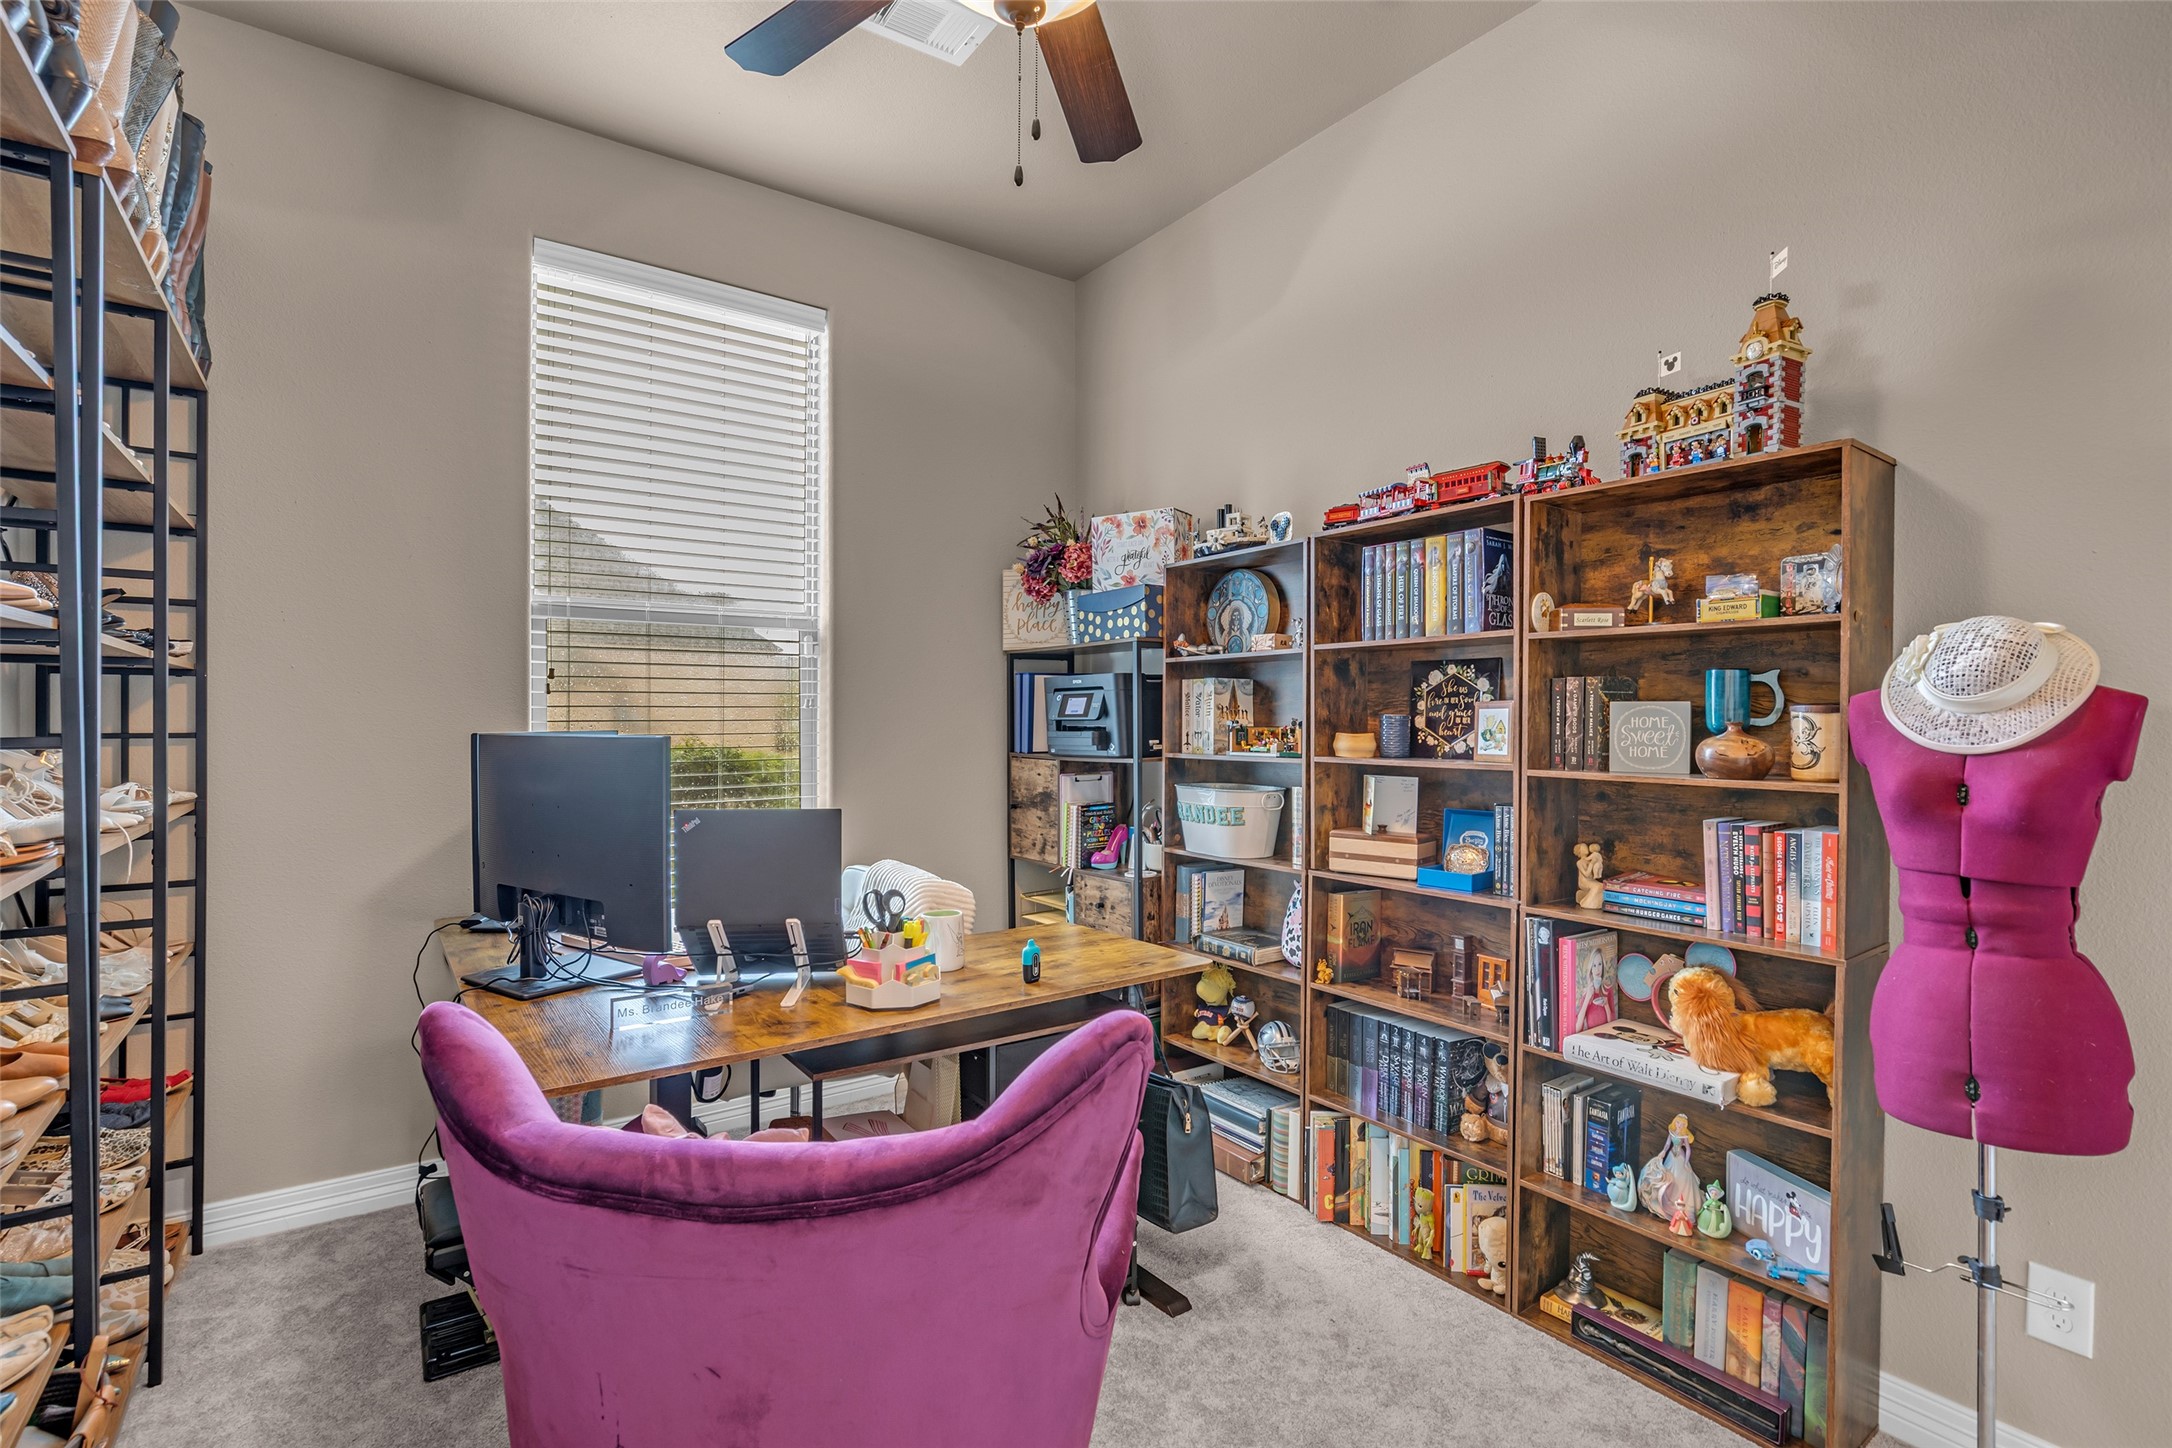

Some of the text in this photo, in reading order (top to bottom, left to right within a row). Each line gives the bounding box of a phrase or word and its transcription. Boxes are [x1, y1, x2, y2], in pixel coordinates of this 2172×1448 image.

[1114, 545, 1152, 576] grateful
[1452, 586, 1458, 594] OF
[1012, 592, 1062, 619] happy
[1376, 600, 1382, 608] OF
[1398, 594, 1404, 604] OF
[1486, 594, 1513, 612] THRON
[1018, 611, 1057, 636] place
[1489, 612, 1512, 627] GLAS
[1441, 679, 1459, 696] She
[1216, 703, 1249, 721] Ruin
[1428, 705, 1473, 726] and grace
[1439, 722, 1468, 738] heart
[1631, 716, 1669, 728] HOME
[1620, 724, 1678, 746] Sweet
[1629, 746, 1668, 758] HOME
[1804, 842, 1812, 888] DAUGHTER
[1632, 887, 1663, 896] CATCHING
[1634, 898, 1677, 908] MOCKINGJAY
[1348, 936, 1374, 948] FLAME
[617, 994, 724, 1018] Ms. Brandee Hake
[1572, 1045, 1590, 1060] The
[1592, 1050, 1610, 1065] Art
[1612, 1056, 1624, 1068] of
[1626, 1059, 1652, 1076] Walt
[1656, 1067, 1696, 1091] Disney
[1589, 1107, 1608, 1120] FANTASIA
[1617, 1104, 1635, 1125] FANTASIA
[1466, 1168, 1506, 1184] GRIM
[1741, 1177, 1750, 1186] do
[1473, 1190, 1506, 1201] The Velve
[1735, 1183, 1822, 1263] HAPPY
[1557, 1303, 1571, 1317] HAR
